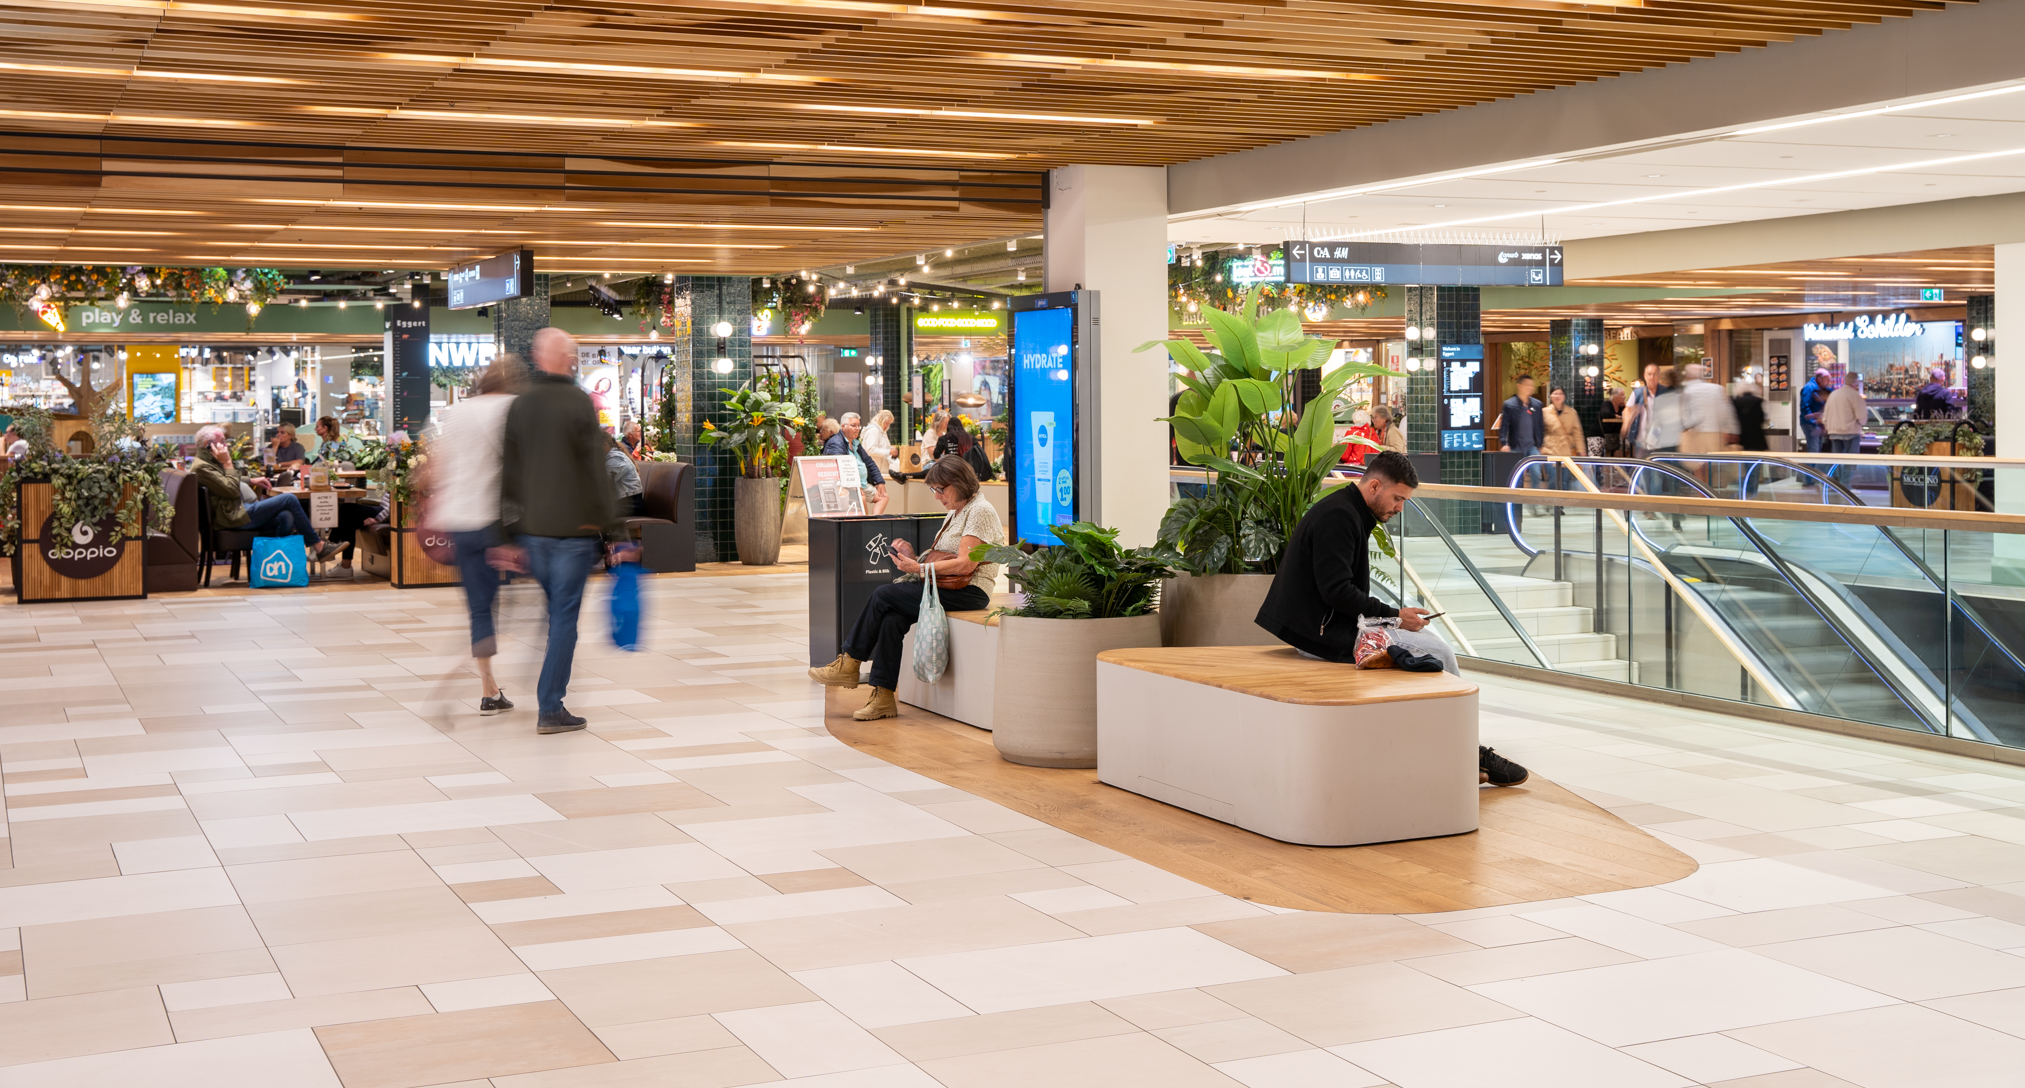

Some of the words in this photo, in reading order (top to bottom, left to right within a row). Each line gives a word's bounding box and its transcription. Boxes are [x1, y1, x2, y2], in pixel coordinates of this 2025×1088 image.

[81, 308, 124, 327] play
[128, 308, 143, 324] &
[148, 309, 198, 324] relax
[396, 319, 426, 328] Eggert
[1854, 312, 1925, 339] Schilder
[1023, 353, 1063, 369] HYDRATE
[424, 534, 455, 549] dop
[48, 545, 117, 561] doppio
